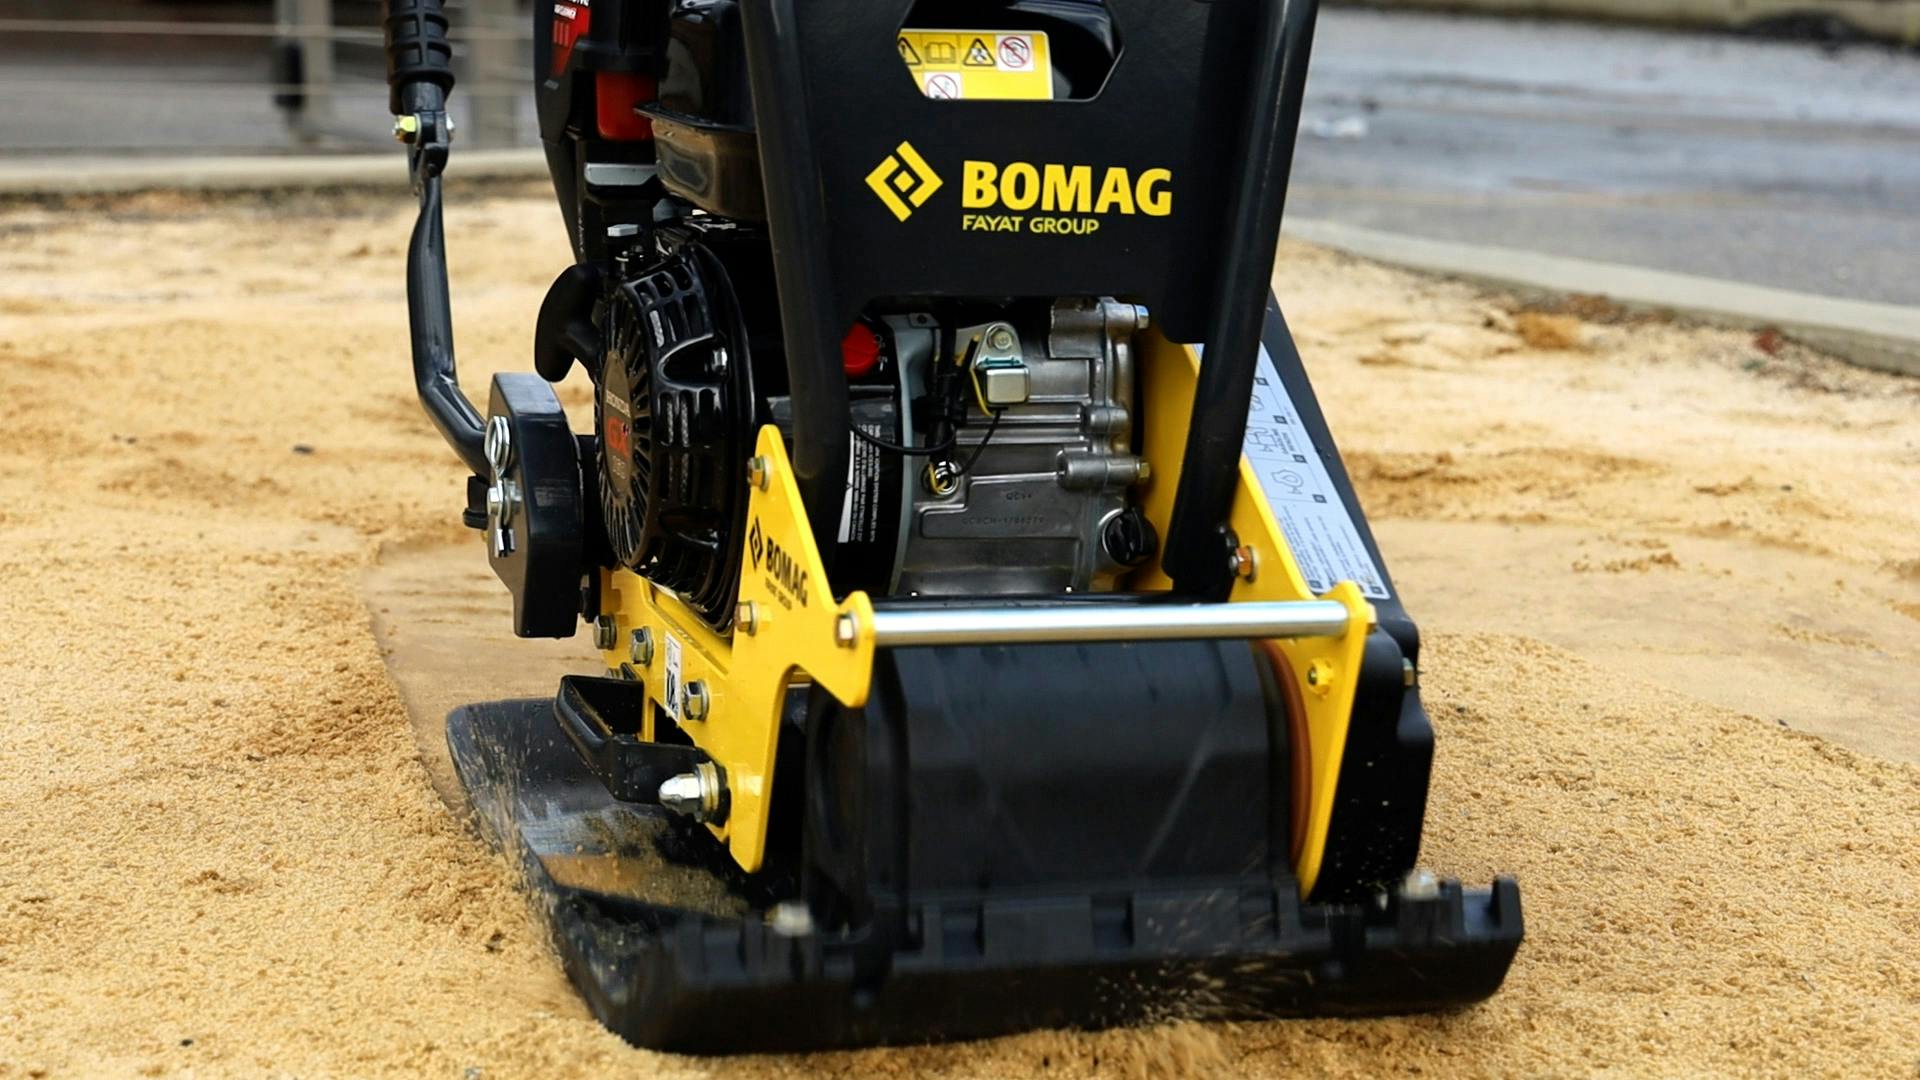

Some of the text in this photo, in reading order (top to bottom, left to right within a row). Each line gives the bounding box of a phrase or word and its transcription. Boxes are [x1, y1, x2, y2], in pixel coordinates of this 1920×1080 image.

[962, 160, 1172, 217] BOMAG
[962, 214, 1100, 235] FAYAT GROUP
[766, 536, 809, 609] BOMAG
